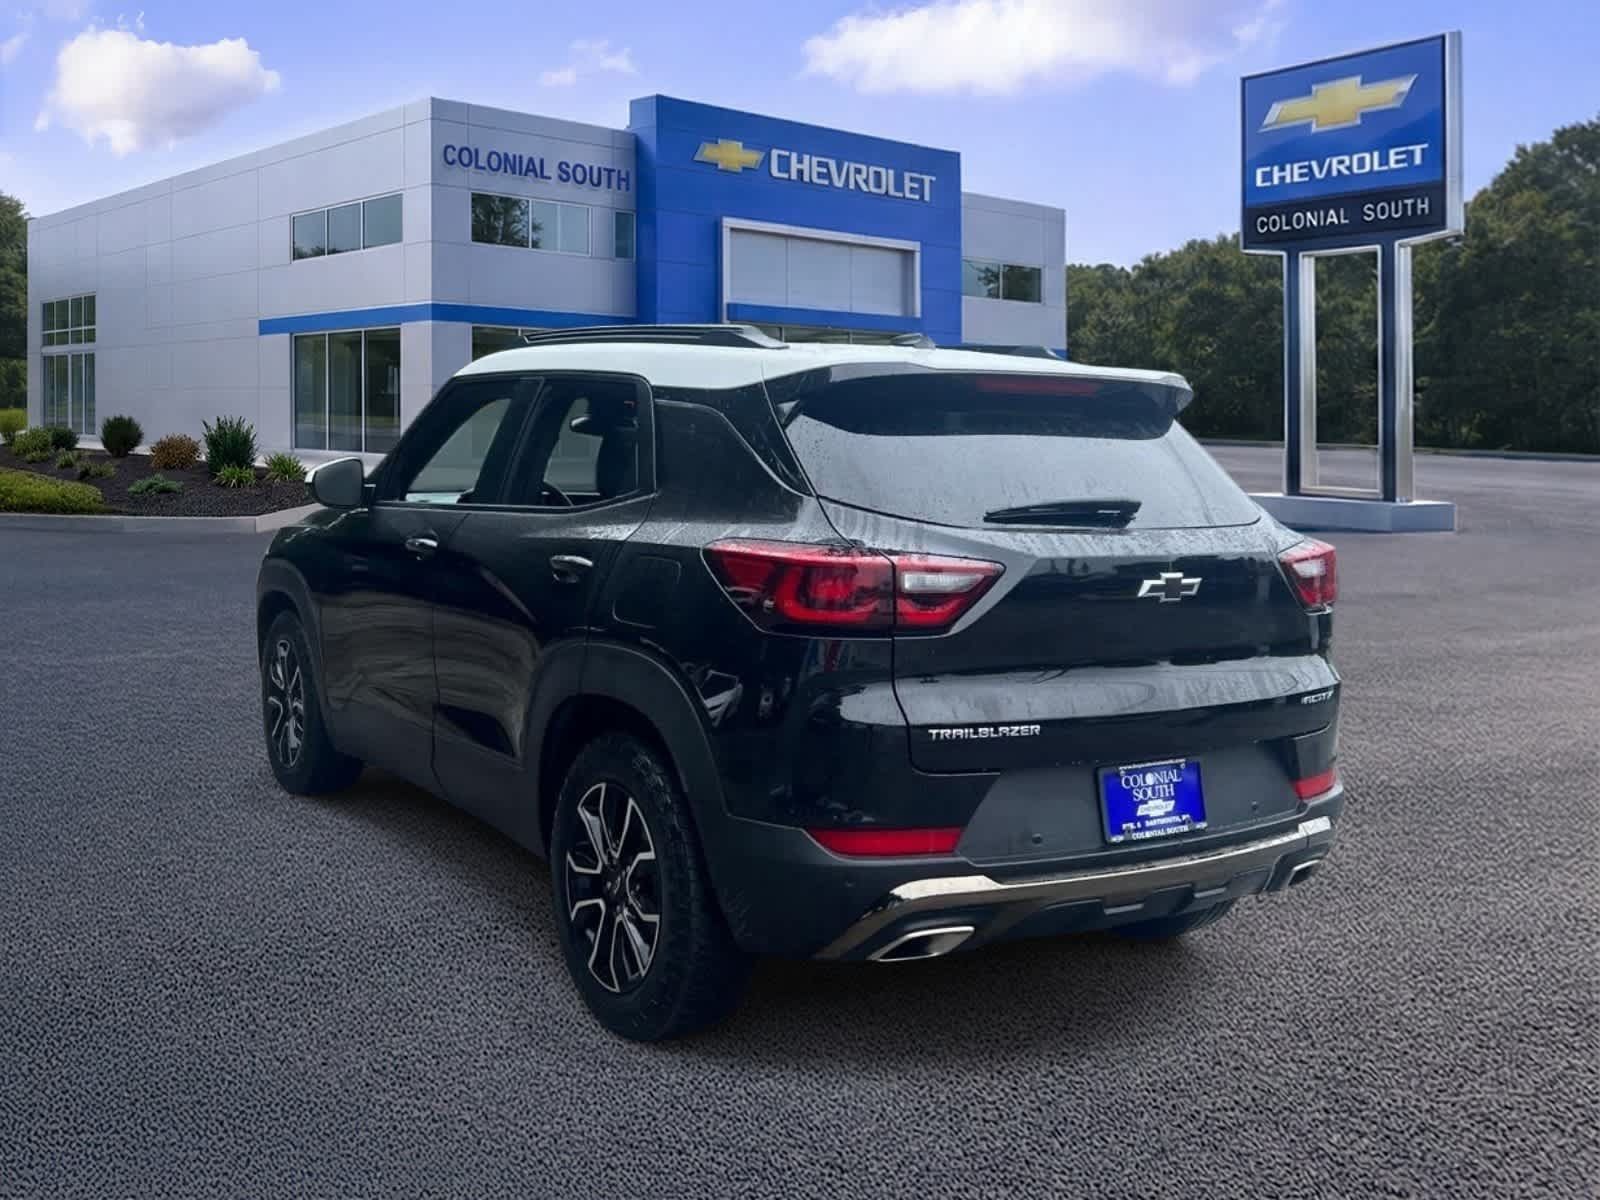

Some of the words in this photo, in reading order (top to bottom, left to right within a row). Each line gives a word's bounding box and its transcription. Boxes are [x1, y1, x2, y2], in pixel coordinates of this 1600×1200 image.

[443, 143, 552, 181] COLONIAL
[557, 160, 631, 192] SOUTH
[769, 147, 936, 202] CHEVROLET
[1255, 143, 1429, 188] CHEVROLET
[1256, 207, 1349, 234] COLONIAL
[1362, 197, 1430, 222] SOUTH
[927, 724, 1041, 742] TRAILBLAZER
[1121, 769, 1183, 789] COLONIAL
[1132, 783, 1175, 802] SOUTH
